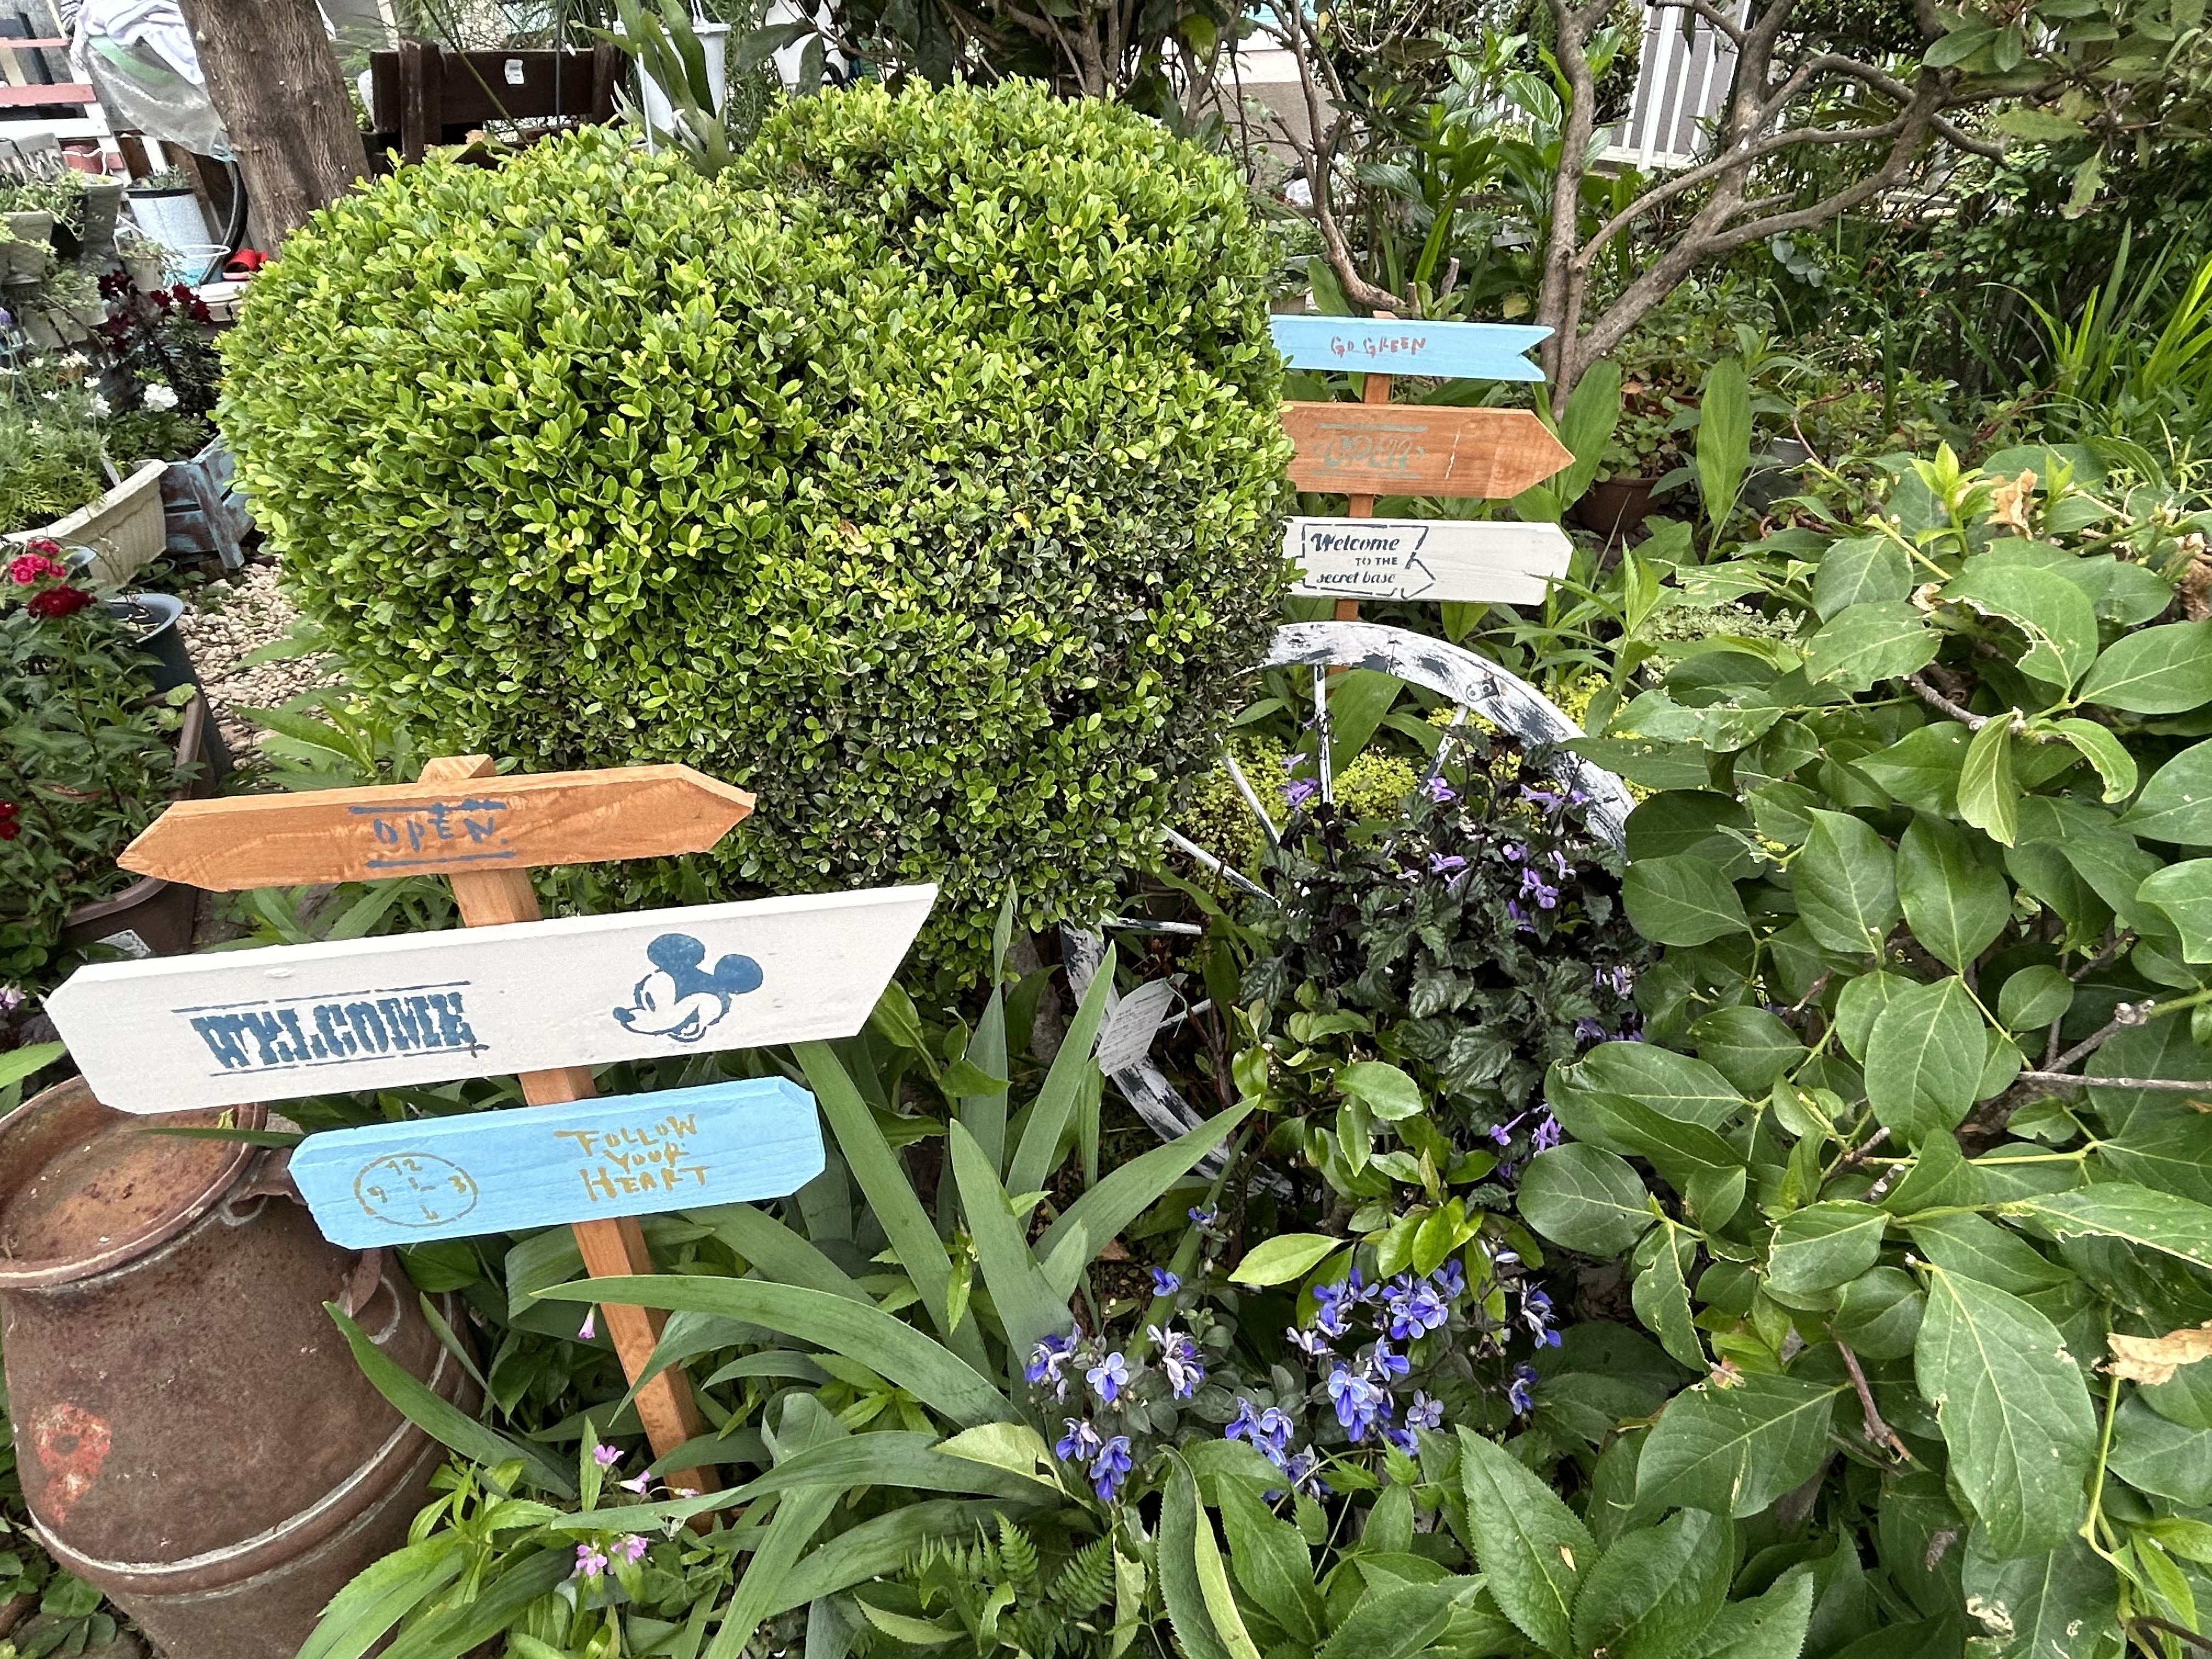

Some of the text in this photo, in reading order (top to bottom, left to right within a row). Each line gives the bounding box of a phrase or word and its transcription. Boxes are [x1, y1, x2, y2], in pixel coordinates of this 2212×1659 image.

[1363, 336, 1426, 357] GREEN
[1310, 533, 1400, 552] Welcome
[1356, 557, 1398, 566] TO THE
[1317, 571, 1396, 584] secret base
[189, 992, 477, 1069] WELCOME
[554, 1114, 697, 1156] FOLLOW
[603, 1141, 690, 1174] YOUR
[448, 1175, 467, 1194] 3
[579, 1166, 711, 1201] HEART
